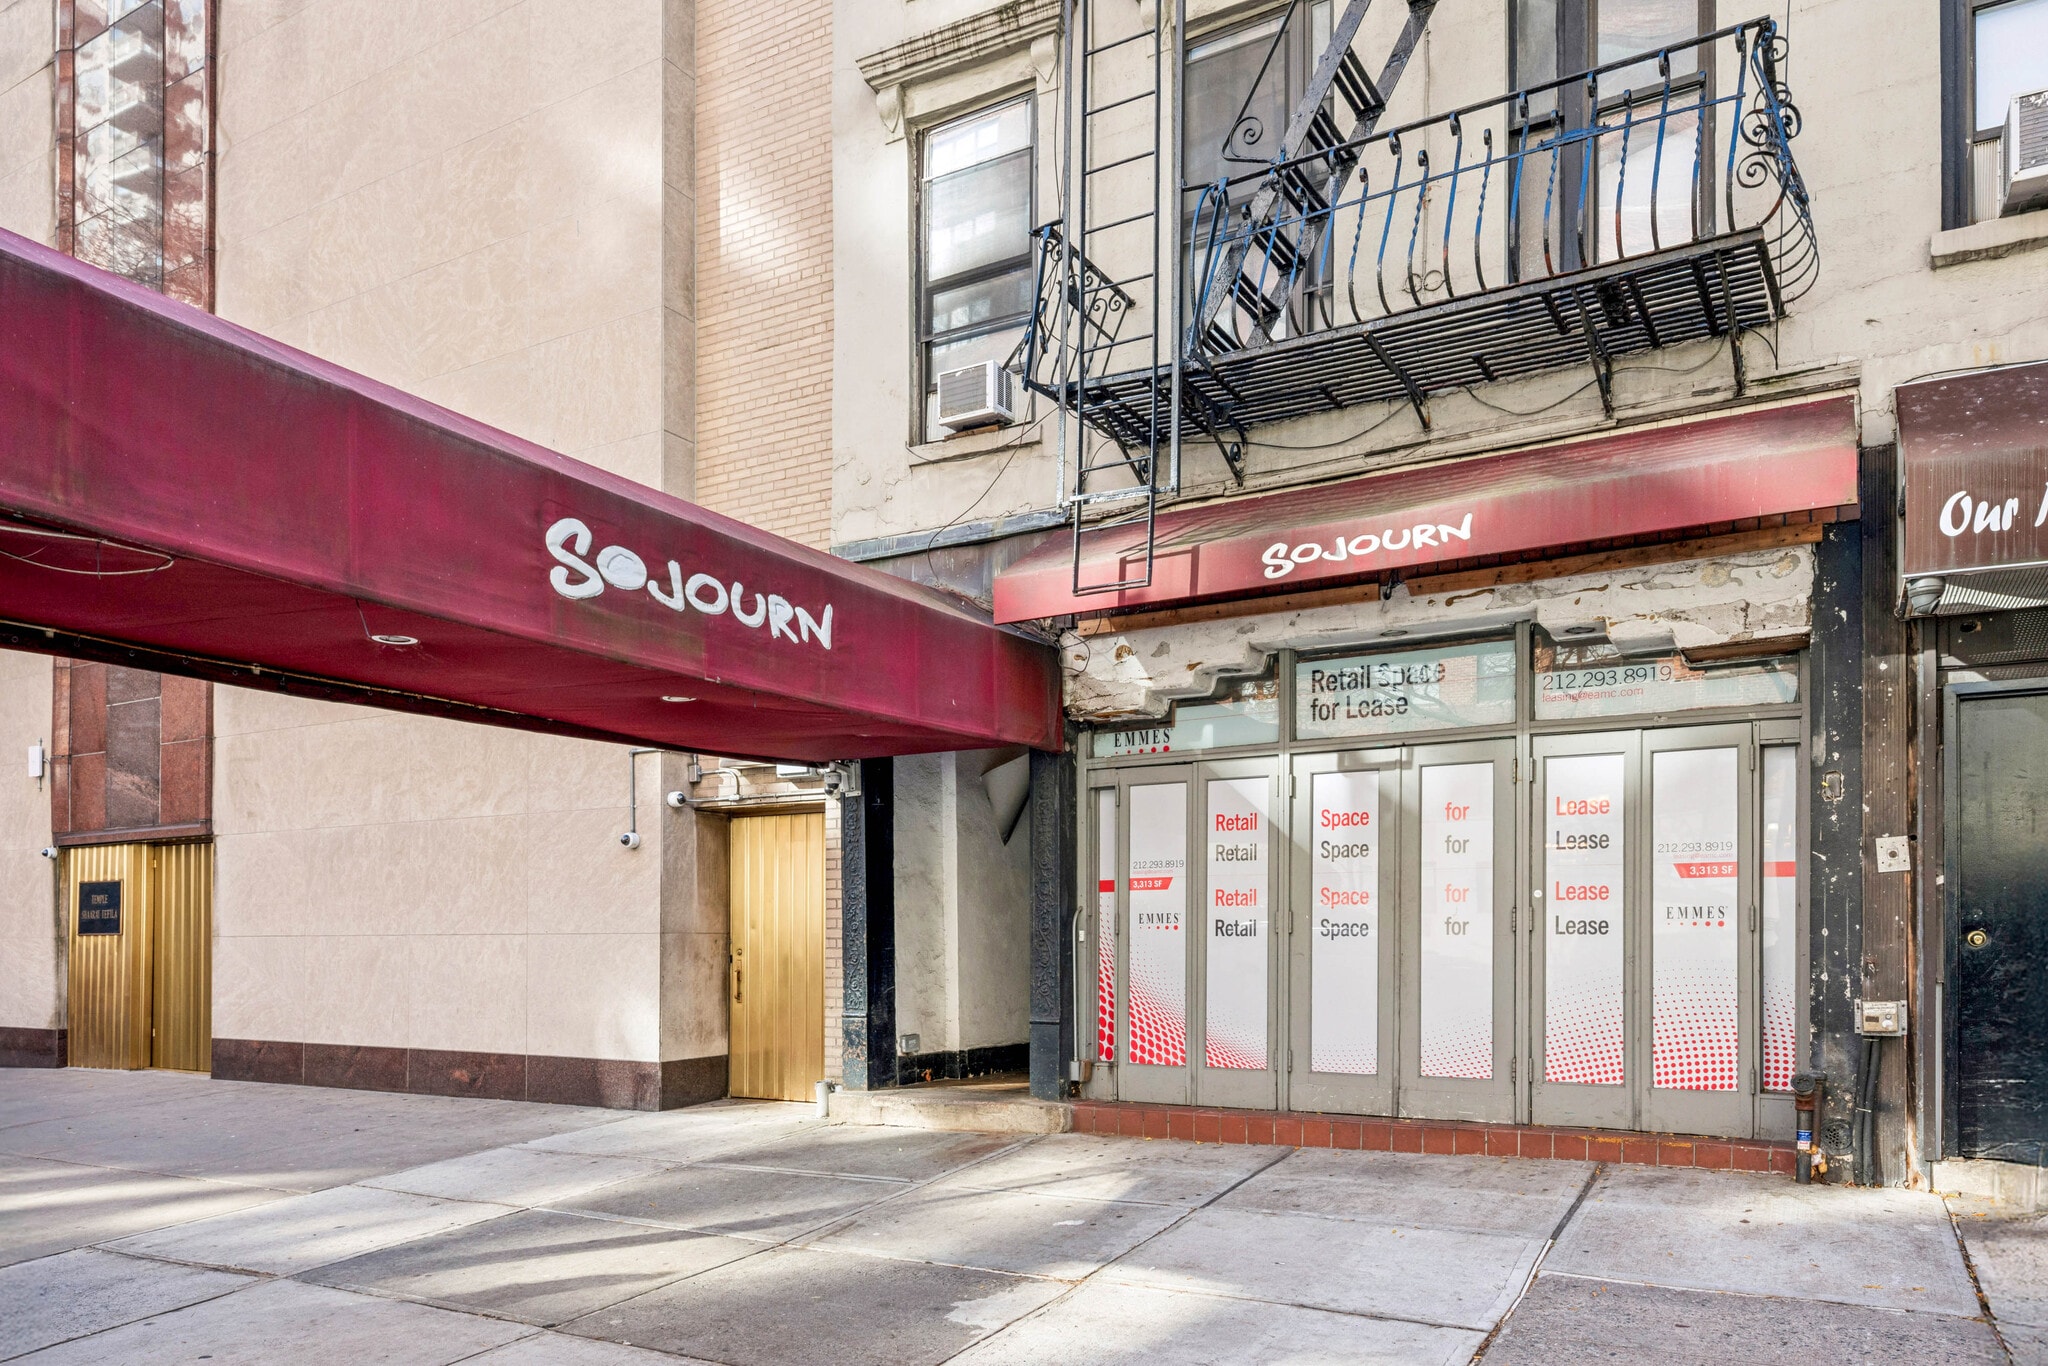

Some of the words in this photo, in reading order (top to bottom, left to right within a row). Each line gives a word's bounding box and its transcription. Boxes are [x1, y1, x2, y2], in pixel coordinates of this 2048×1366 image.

[1939, 491, 2019, 536] Our
[1262, 512, 1473, 579] SOJOURN
[545, 518, 833, 650] SOJOURN
[1311, 665, 1371, 693] Retail
[1378, 662, 1446, 691] Space
[1543, 666, 1672, 690] 212.293.8919
[1311, 698, 1340, 721] for
[1346, 695, 1408, 719] Lease
[1114, 728, 1170, 748] EMMES
[1216, 813, 1258, 831] Retail
[1321, 809, 1369, 830] Space
[1445, 802, 1470, 821] for
[1556, 796, 1610, 816] Lease
[1215, 843, 1257, 862] Retail
[1321, 841, 1369, 862] Space
[1445, 835, 1470, 854] for
[1556, 830, 1610, 850] Lease
[1657, 841, 1733, 853] 212.293.8919
[1133, 859, 1185, 870] 212.293.8919
[1690, 866, 1719, 876] 3,313
[1721, 865, 1734, 874] SF
[1133, 880, 1153, 889] 3,313
[1153, 880, 1163, 888] SF
[1215, 888, 1257, 907] Retail
[1320, 887, 1369, 909] Space
[1445, 883, 1470, 902] for
[1555, 881, 1610, 901] Lease
[1138, 912, 1179, 924] EMMES
[1666, 905, 1725, 920] EMMES
[1215, 919, 1257, 937] Retail
[1320, 918, 1369, 940] Space
[1444, 916, 1470, 936] for
[1555, 915, 1609, 935] Lease
